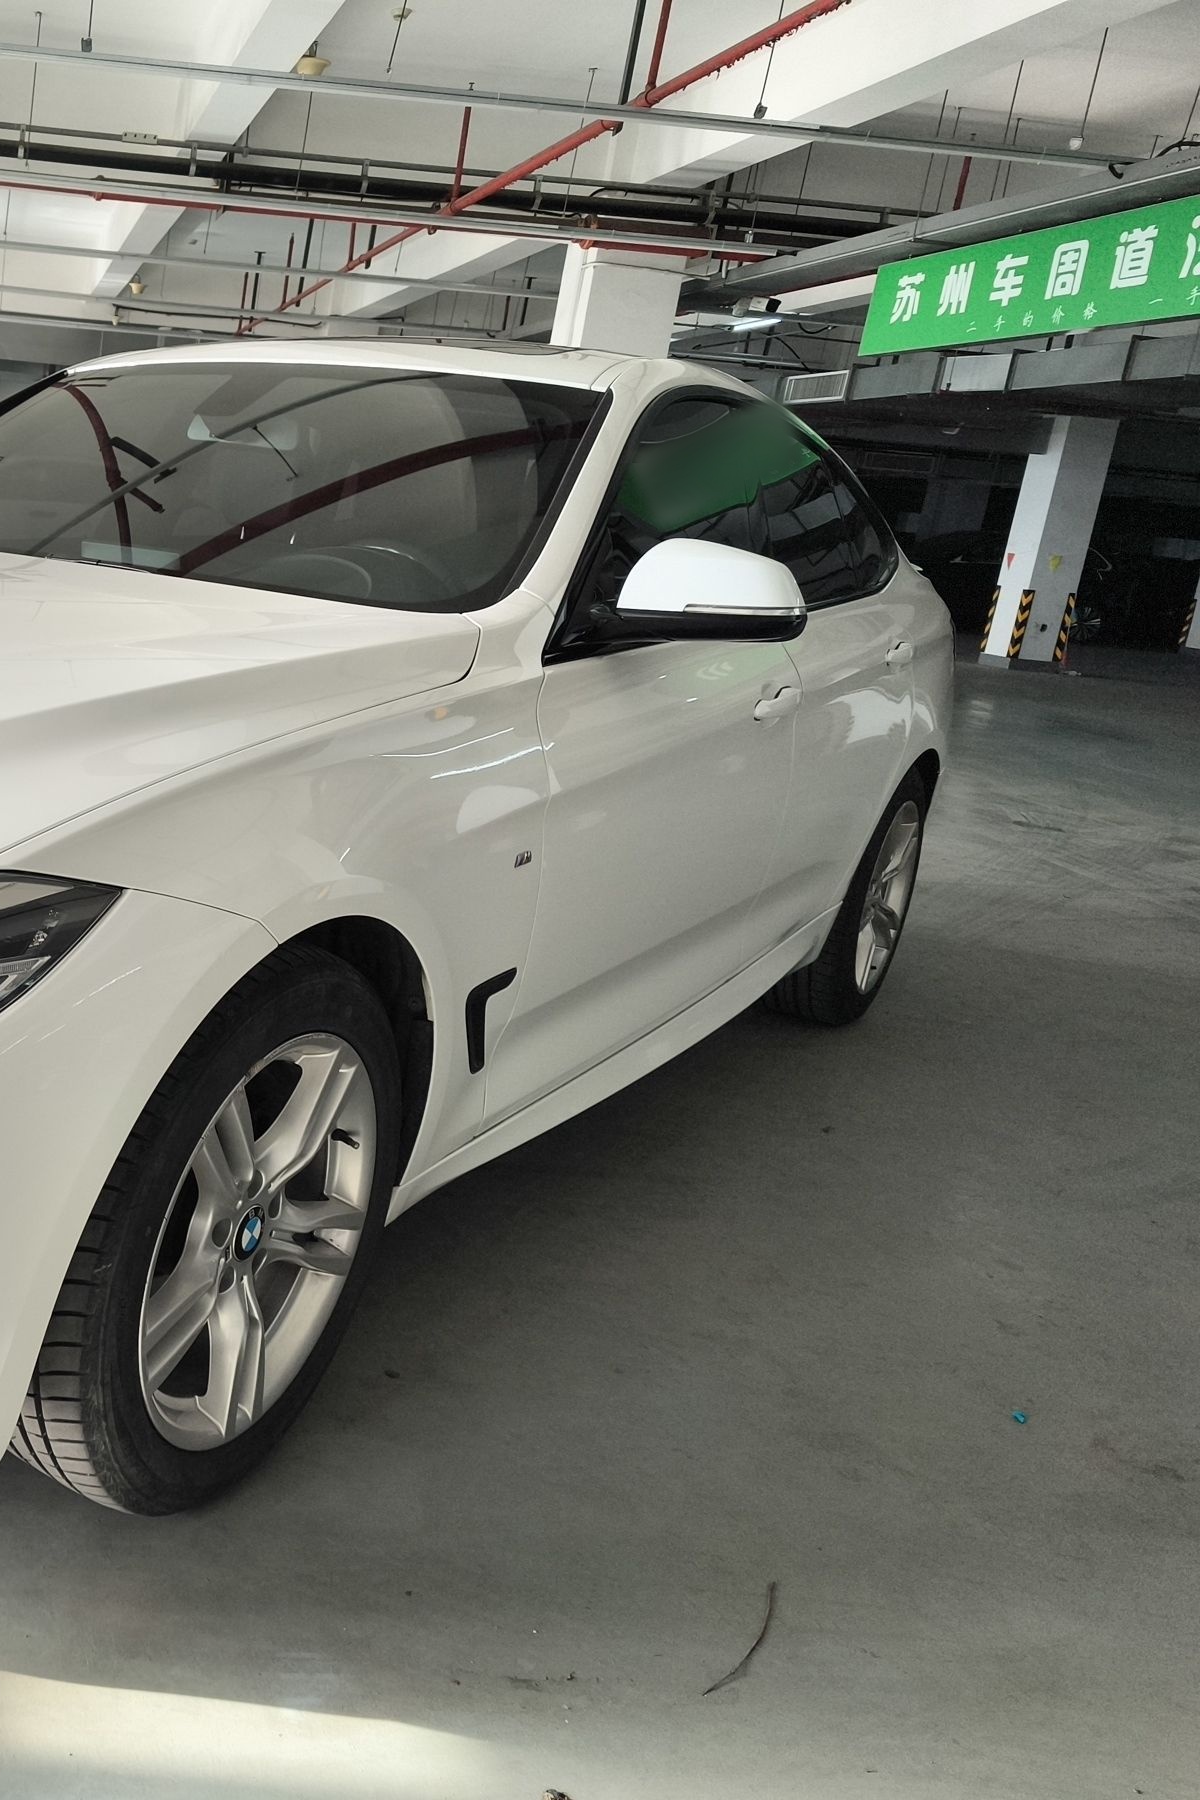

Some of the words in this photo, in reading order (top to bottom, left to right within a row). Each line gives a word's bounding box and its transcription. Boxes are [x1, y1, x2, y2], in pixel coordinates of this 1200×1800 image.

[966, 301, 1098, 333] 二手的价格
